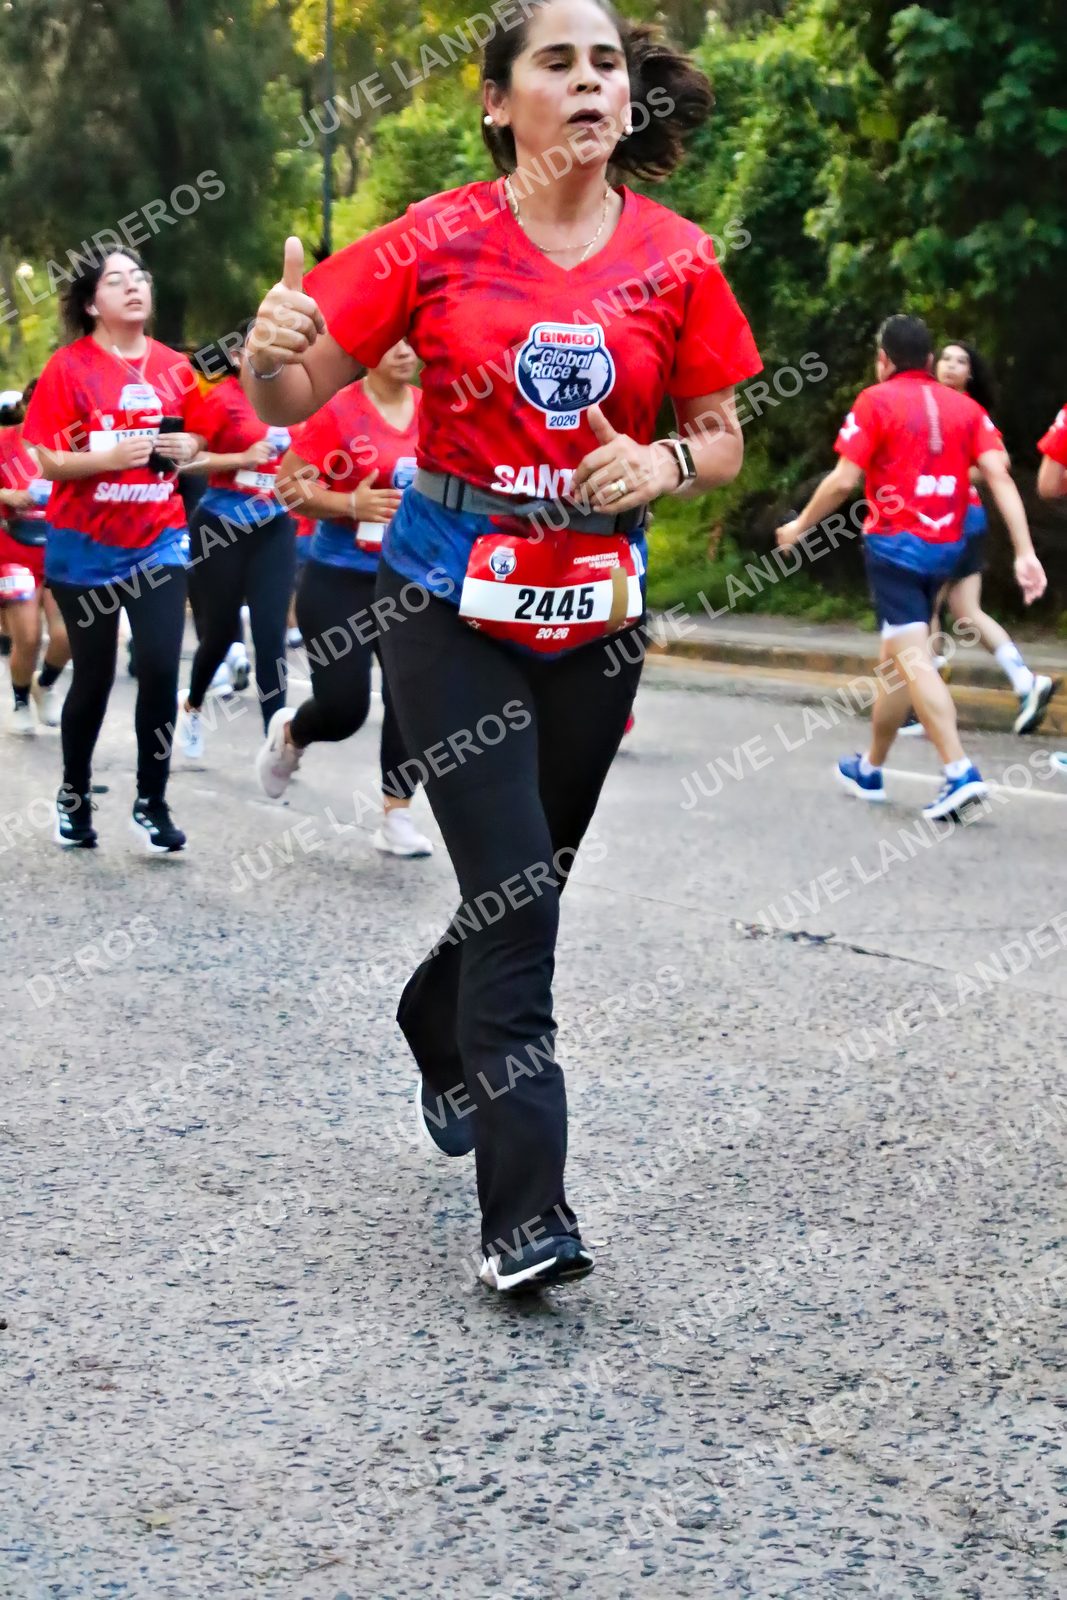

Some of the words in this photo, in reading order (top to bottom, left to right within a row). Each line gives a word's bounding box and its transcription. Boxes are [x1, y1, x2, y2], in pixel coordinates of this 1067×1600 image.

[540, 332, 595, 346] BIMBO
[540, 349, 594, 369] Global
[530, 361, 572, 379] Race
[549, 415, 577, 428] 2026
[514, 586, 594, 621] 2445
